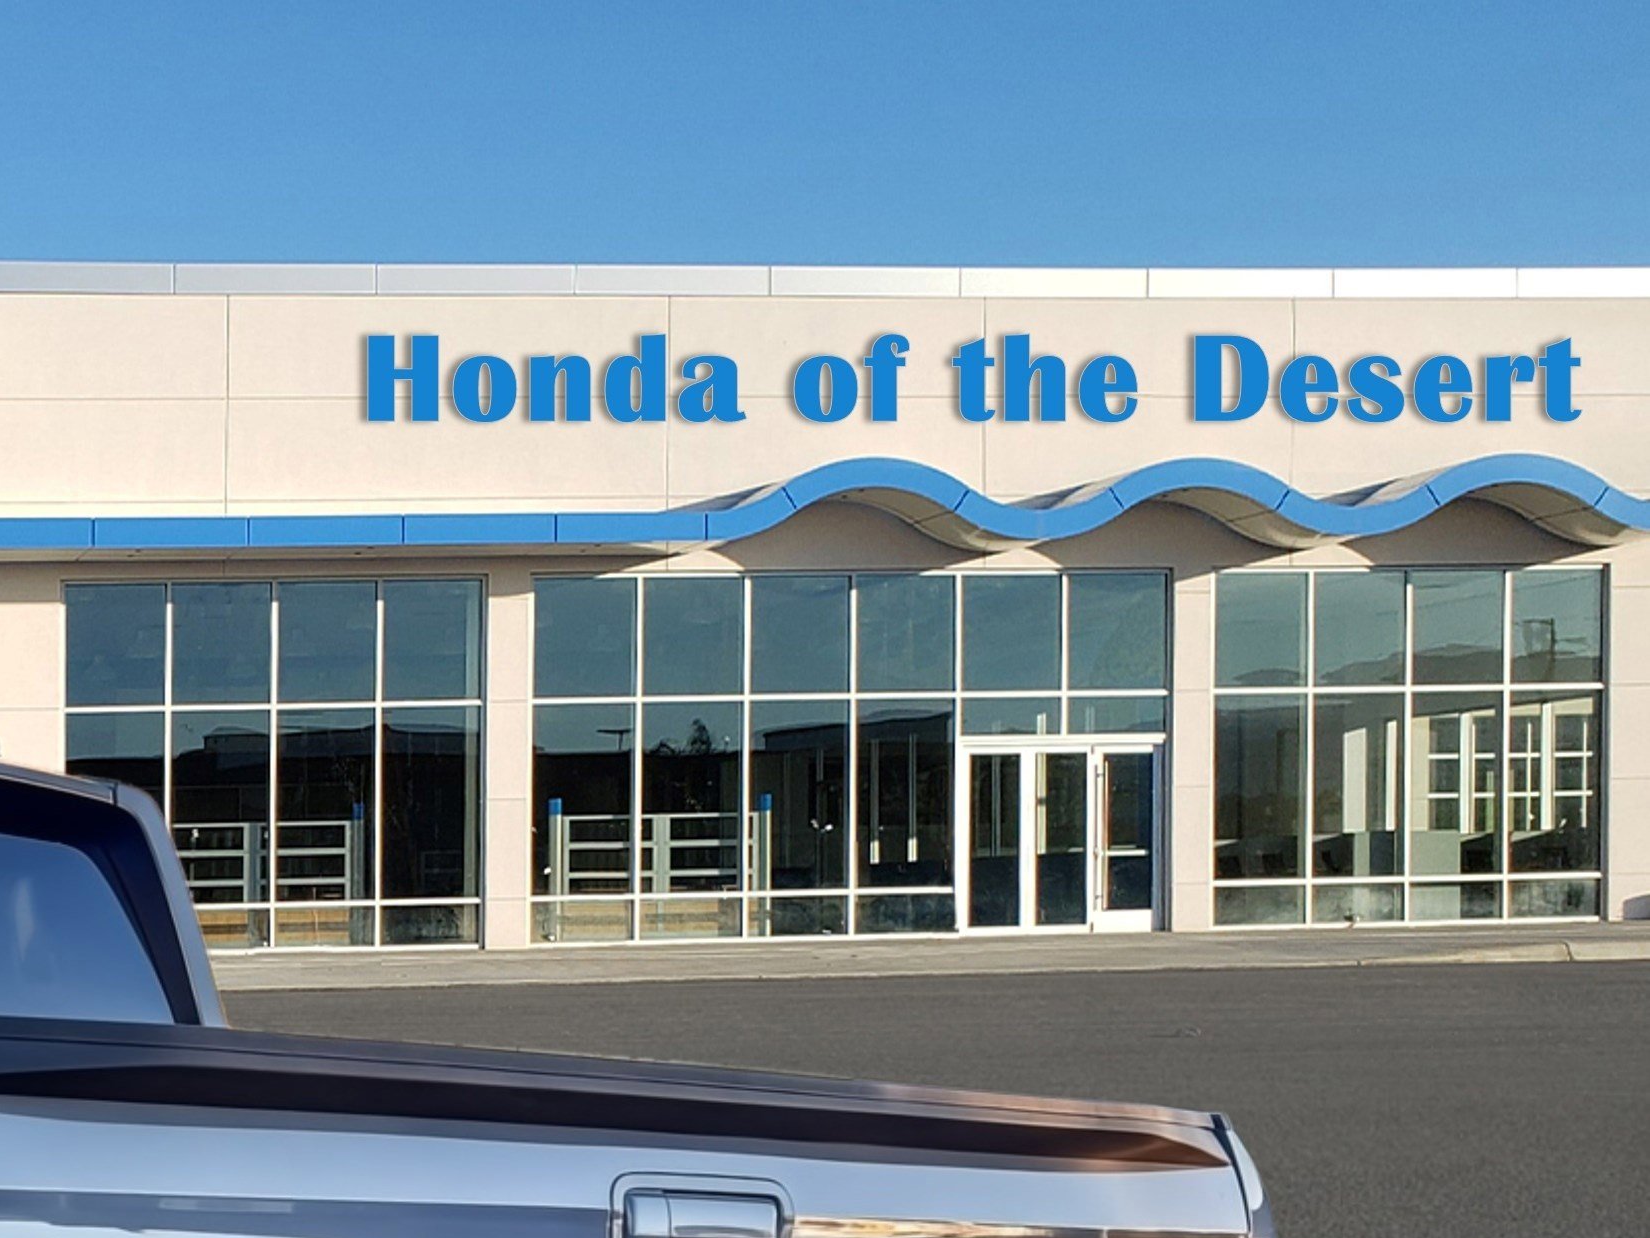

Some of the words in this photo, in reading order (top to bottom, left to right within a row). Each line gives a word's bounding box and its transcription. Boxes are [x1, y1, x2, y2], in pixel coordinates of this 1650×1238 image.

[366, 333, 748, 424] Honda
[793, 332, 911, 424] of
[951, 332, 1139, 424] the
[1193, 334, 1583, 424] Desert
